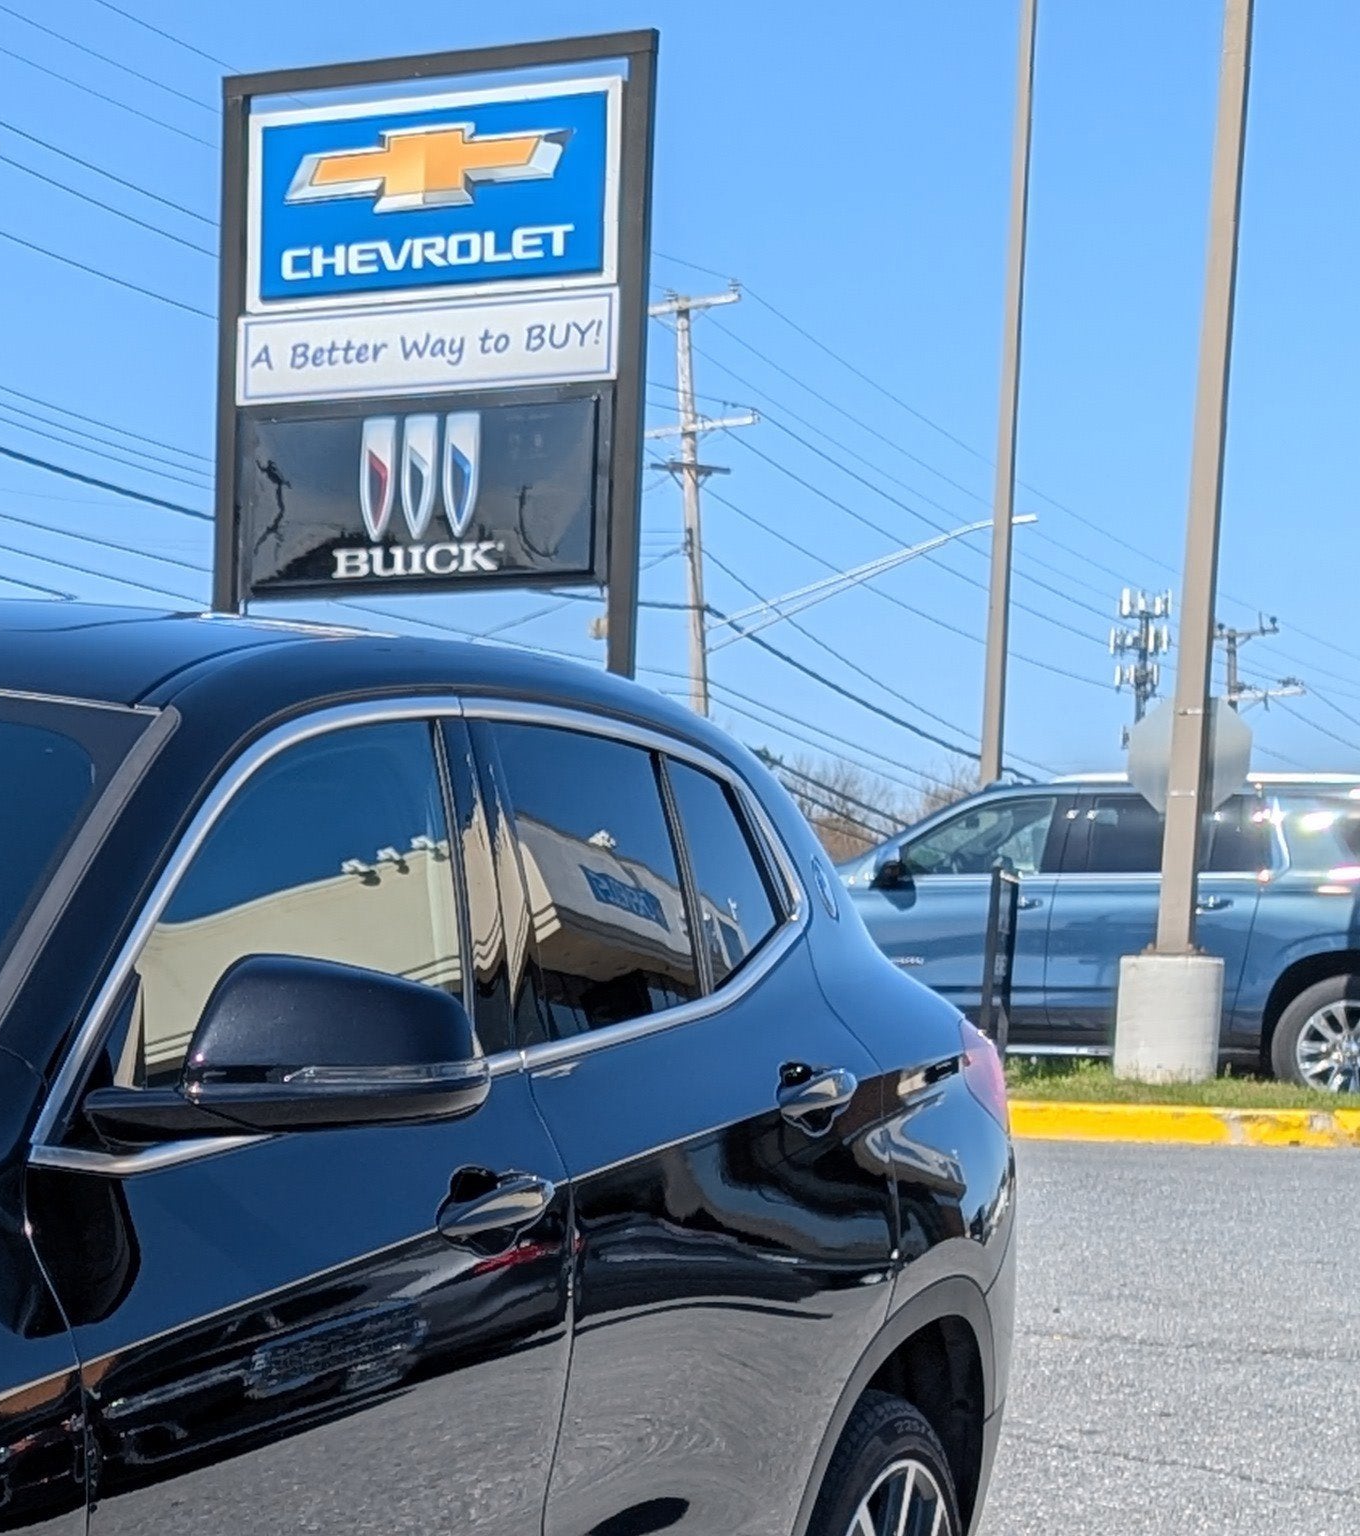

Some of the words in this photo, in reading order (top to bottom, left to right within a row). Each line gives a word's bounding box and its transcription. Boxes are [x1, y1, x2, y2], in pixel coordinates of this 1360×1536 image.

[281, 223, 575, 280] CHEVROLET
[250, 344, 275, 370] A
[290, 339, 387, 370] Better
[400, 332, 465, 365] Way
[479, 329, 510, 354] to
[525, 319, 603, 352] BUY!
[331, 541, 500, 579] BUICK
